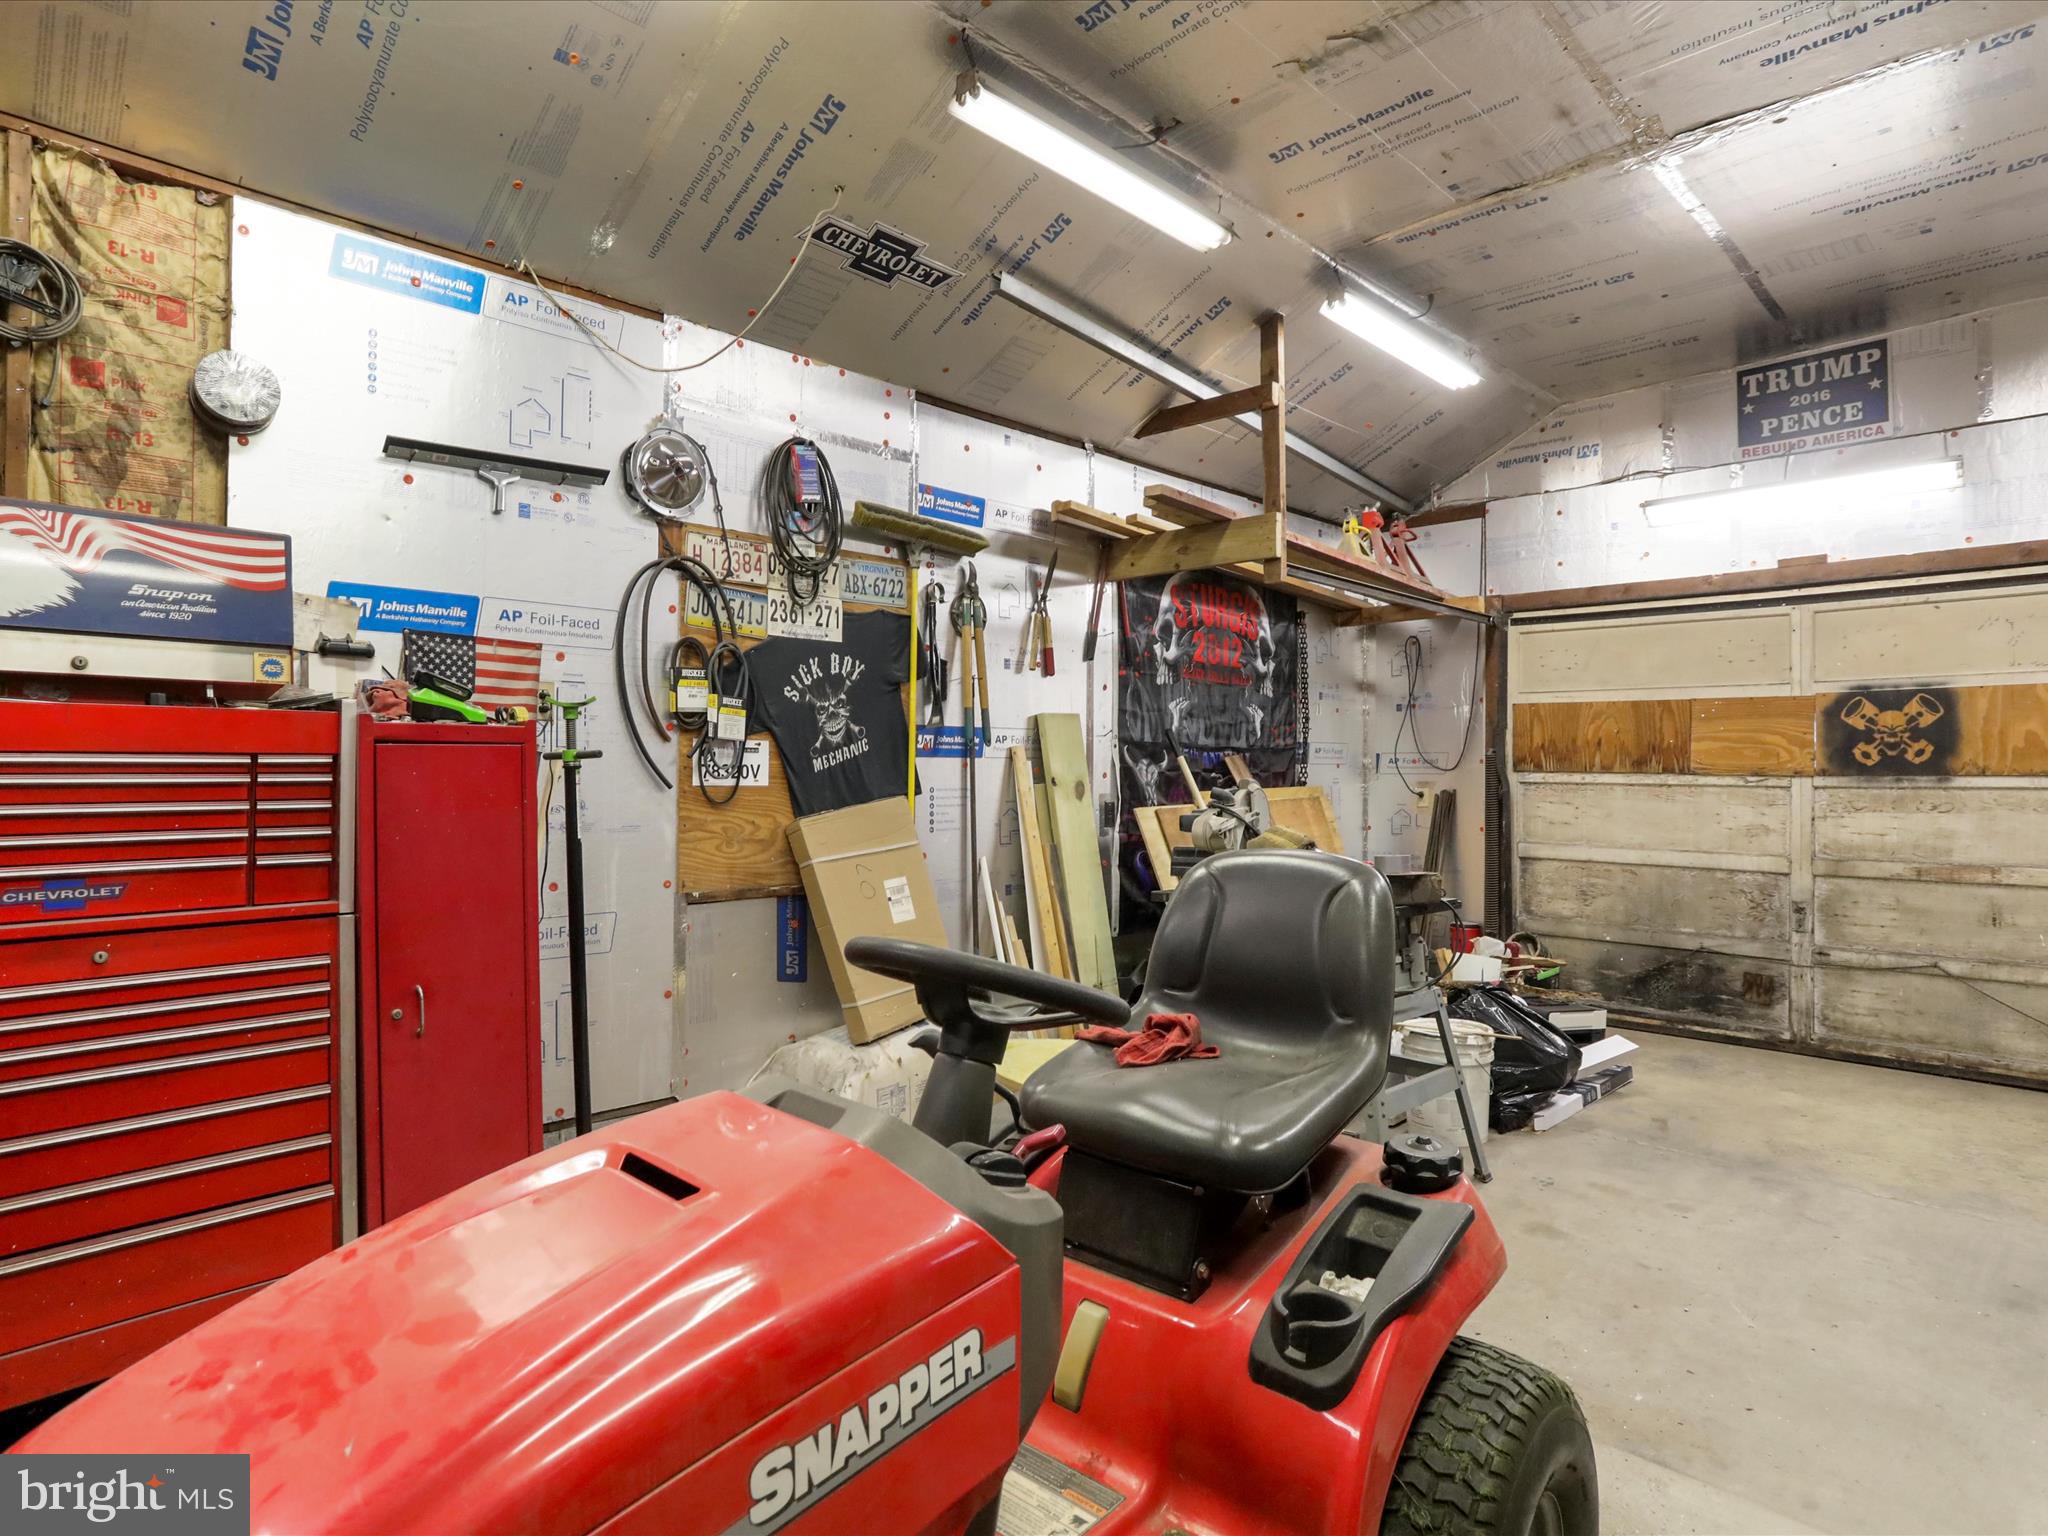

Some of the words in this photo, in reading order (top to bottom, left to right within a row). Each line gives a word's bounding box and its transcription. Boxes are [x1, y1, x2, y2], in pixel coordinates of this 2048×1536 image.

[356, 18, 374, 49] AP
[1171, 12, 1191, 29] AP
[1109, 16, 1210, 80] Polyisocyanurate
[1760, 22, 1868, 68] Manville
[350, 20, 401, 142] Polyisocyanurate
[719, 36, 790, 143] Polyisocyanurate
[740, 120, 755, 144] AP
[1308, 123, 1358, 150] Johns
[1357, 87, 1435, 127] Manville
[753, 130, 784, 173] Berkshire
[776, 127, 814, 180] Johns
[1286, 152, 1379, 195] Polyisocyanurate
[1382, 122, 1452, 155] Continuous
[1454, 95, 1520, 125] Insulation
[1346, 150, 1365, 162] AP
[679, 143, 724, 208] Continuous
[700, 144, 741, 204] Foil-Faced
[725, 171, 757, 216] Hathaway
[733, 179, 783, 241] Manville
[969, 172, 1039, 252] Polyisocyanurate
[648, 209, 685, 260] Insulation
[701, 214, 730, 254] Company
[985, 234, 998, 255] AP
[107, 239, 155, 265] R-13
[822, 226, 943, 286] CHEVROLET
[1007, 238, 1042, 277] Johns
[384, 260, 421, 277] Johns
[422, 270, 474, 293] Manville
[505, 292, 528, 307] AP
[1170, 316, 1203, 349] Johns
[1742, 348, 1882, 398] TRUMP
[1789, 389, 1831, 408] 2016
[1760, 401, 1864, 438] PENCE
[1812, 425, 1886, 447] AMERICA
[1496, 454, 1541, 469] Manville
[1542, 446, 1574, 459] Johns
[104, 496, 152, 514] R-13
[936, 497, 954, 508] Johns
[995, 508, 1008, 518] AP
[706, 537, 749, 551] MARLAND
[856, 563, 889, 575] VIRGINIA
[169, 612, 193, 621] 1920
[377, 600, 415, 613] Johns
[416, 604, 468, 618] Manville
[499, 609, 523, 622] AP
[530, 612, 600, 630] Foil-Faced
[1170, 582, 1260, 641] STURGIS
[525, 627, 567, 637] Continuous
[568, 631, 603, 640] Insulation
[1192, 630, 1244, 669] 2012
[784, 656, 823, 703] SICK
[830, 652, 866, 681] BOY
[812, 737, 870, 773] MECHANIC
[995, 735, 1008, 744] AP
[3, 886, 124, 903] CHEVROLET
[748, 1327, 985, 1527] SNAPPER
